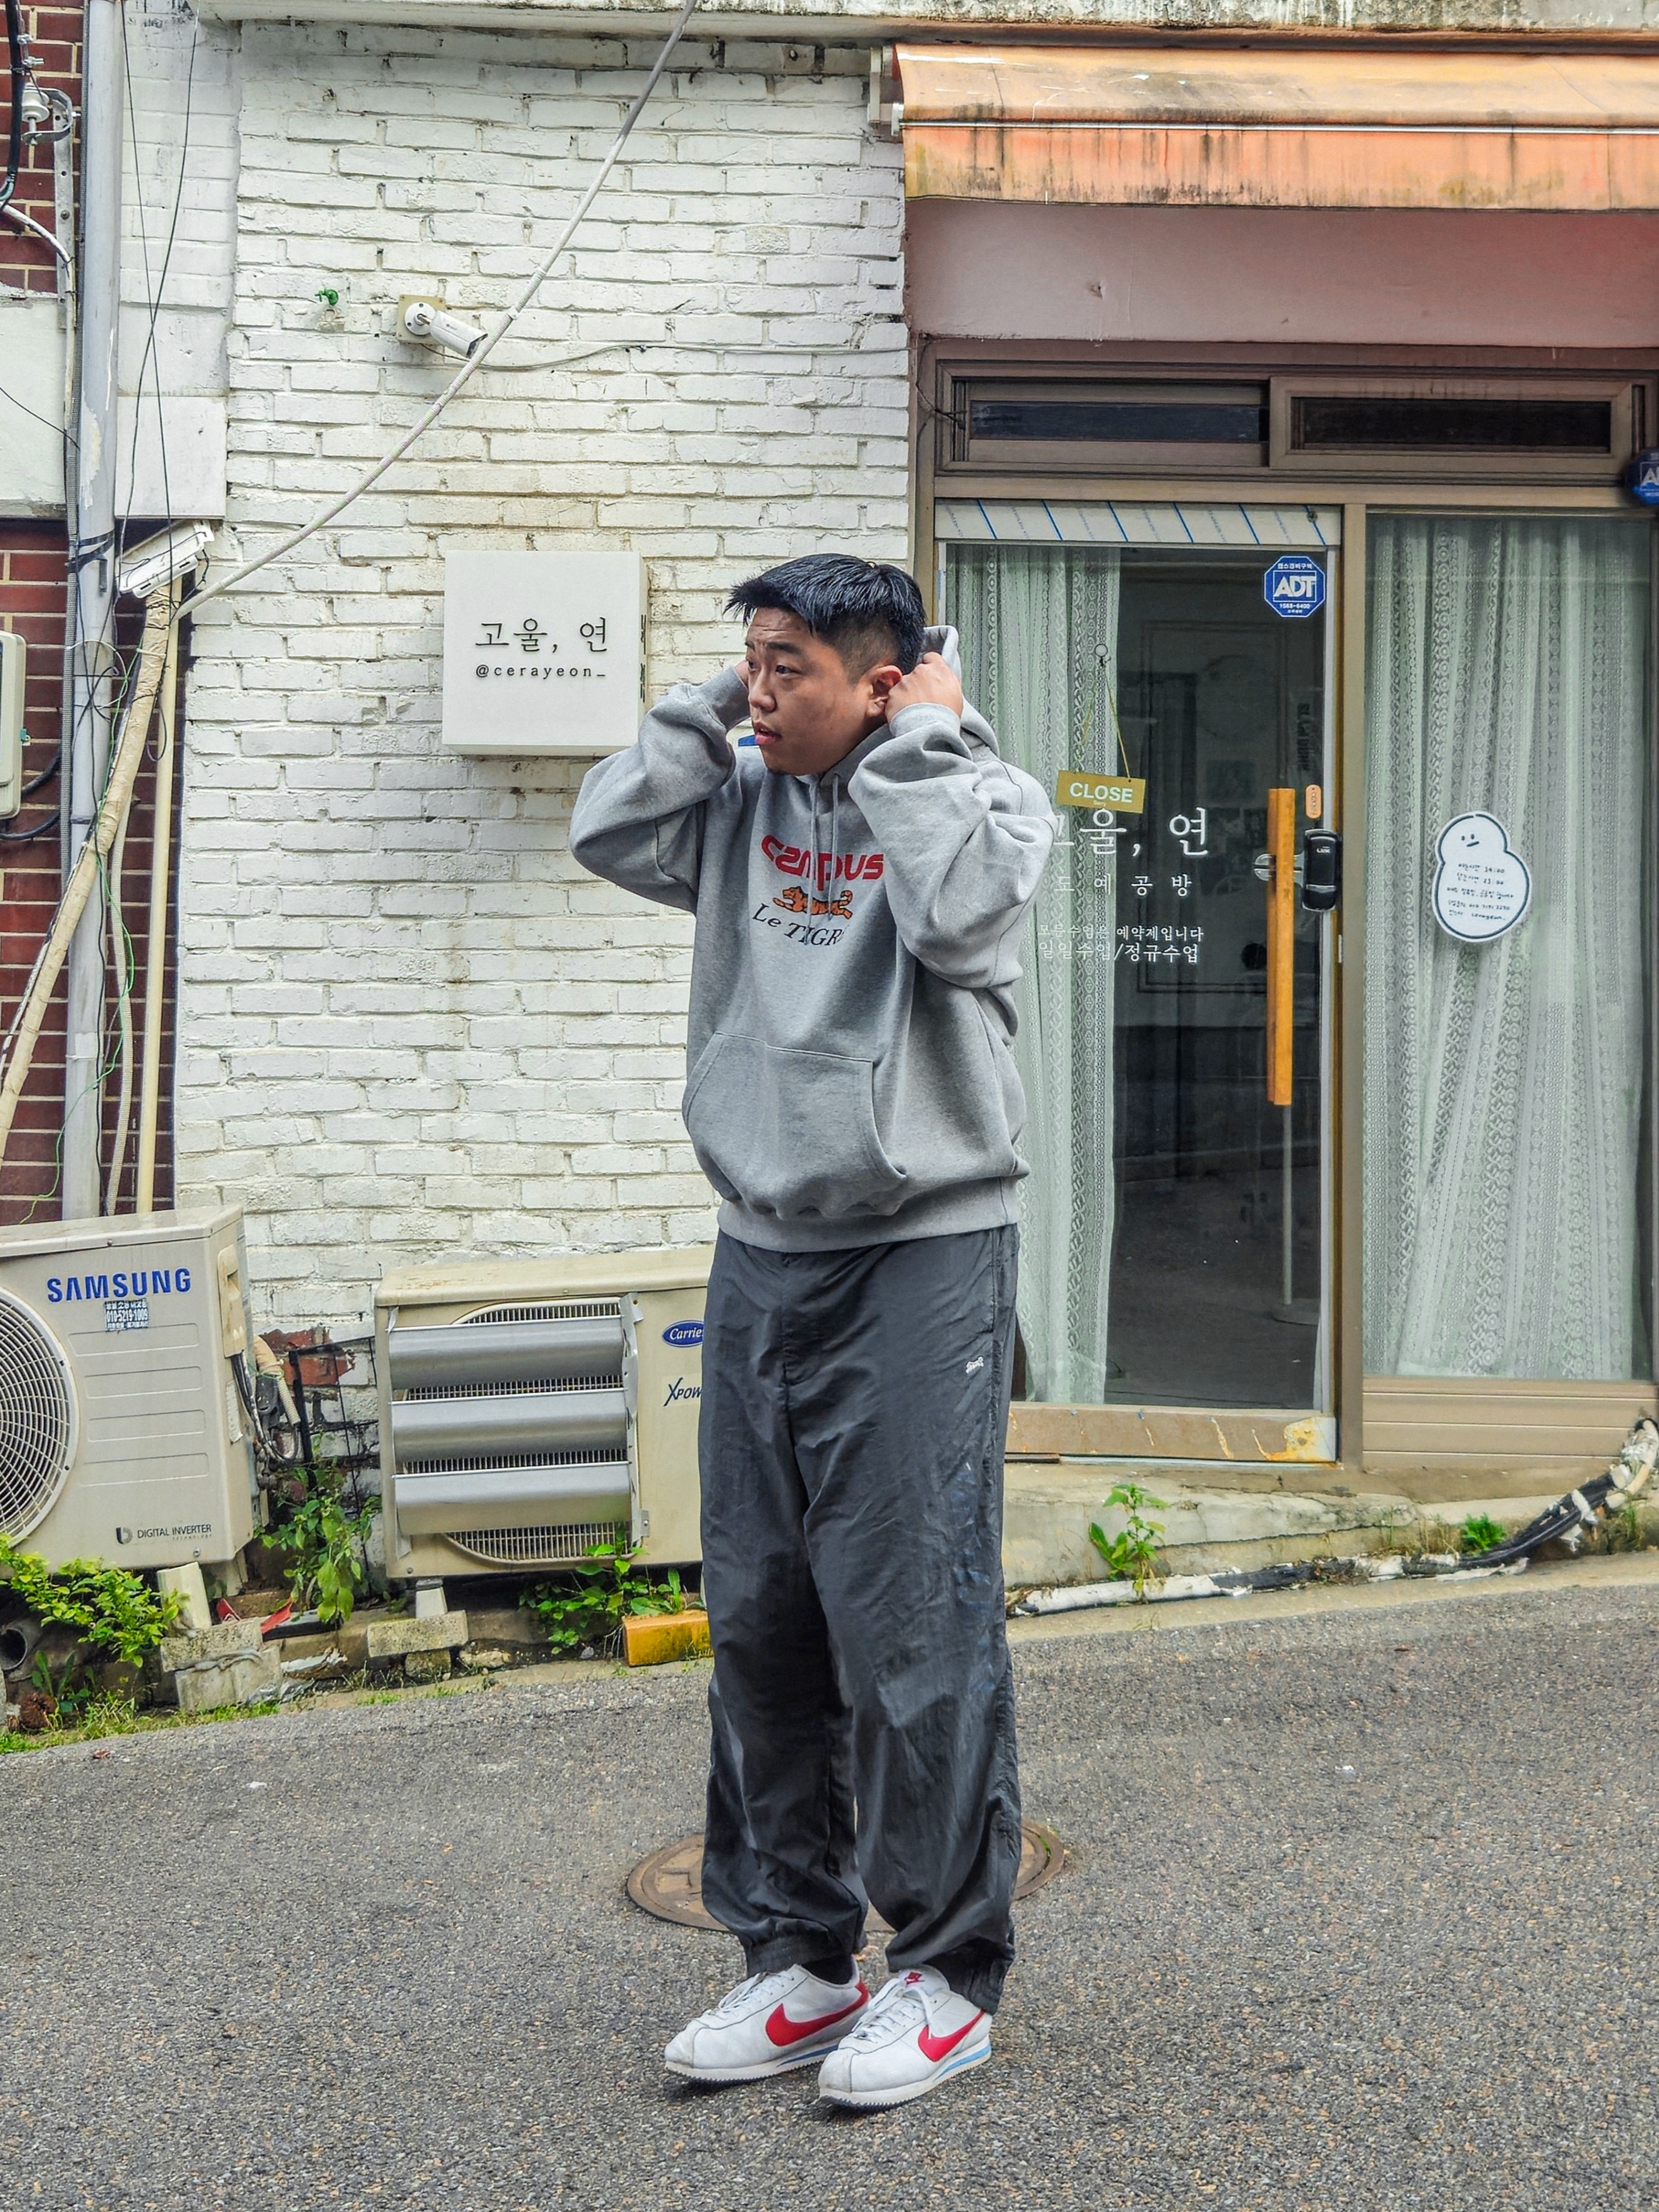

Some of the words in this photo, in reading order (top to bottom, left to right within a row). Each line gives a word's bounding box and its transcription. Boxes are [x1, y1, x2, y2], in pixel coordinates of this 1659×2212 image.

[1274, 576, 1316, 597] ADT
[475, 618, 558, 653] 고울,
[580, 617, 607, 652] 연
[476, 664, 606, 679] @cerayeon_
[1069, 782, 1133, 803] CLOSE
[1169, 807, 1209, 856] 연
[752, 903, 782, 927] Le
[1117, 925, 1204, 942] 예약제입니다
[47, 1267, 192, 1303] SAMSUNG
[669, 1327, 703, 1341] Carrie
[138, 1528, 169, 1538] DIGITAL
[172, 1524, 211, 1535] INVERTER
